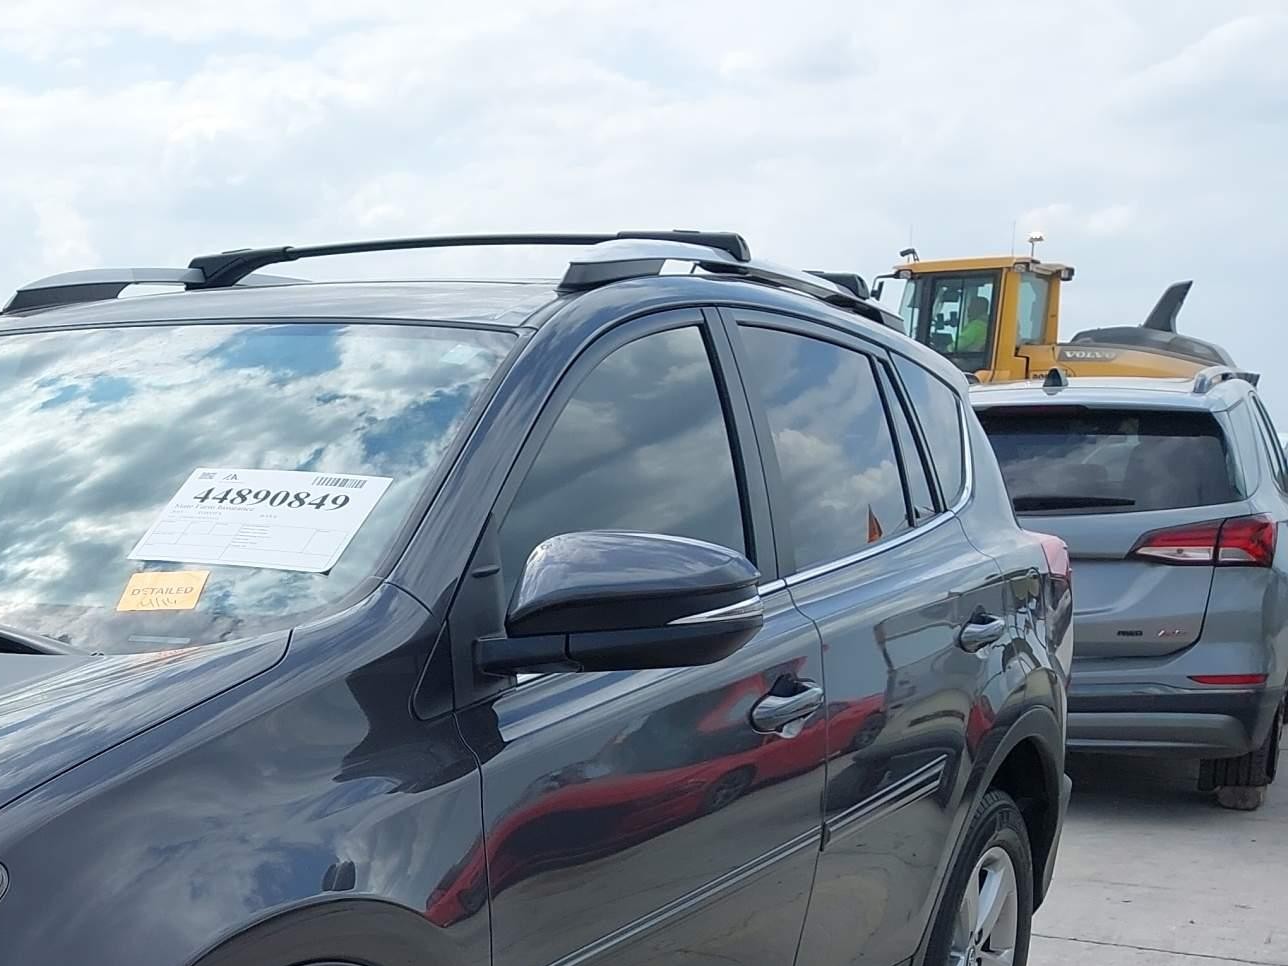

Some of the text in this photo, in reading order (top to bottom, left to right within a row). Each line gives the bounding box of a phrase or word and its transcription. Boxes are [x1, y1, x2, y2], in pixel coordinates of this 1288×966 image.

[1064, 350, 1117, 359] VOLVO
[193, 487, 350, 511] 44890849
[131, 586, 194, 596] DETAILED
